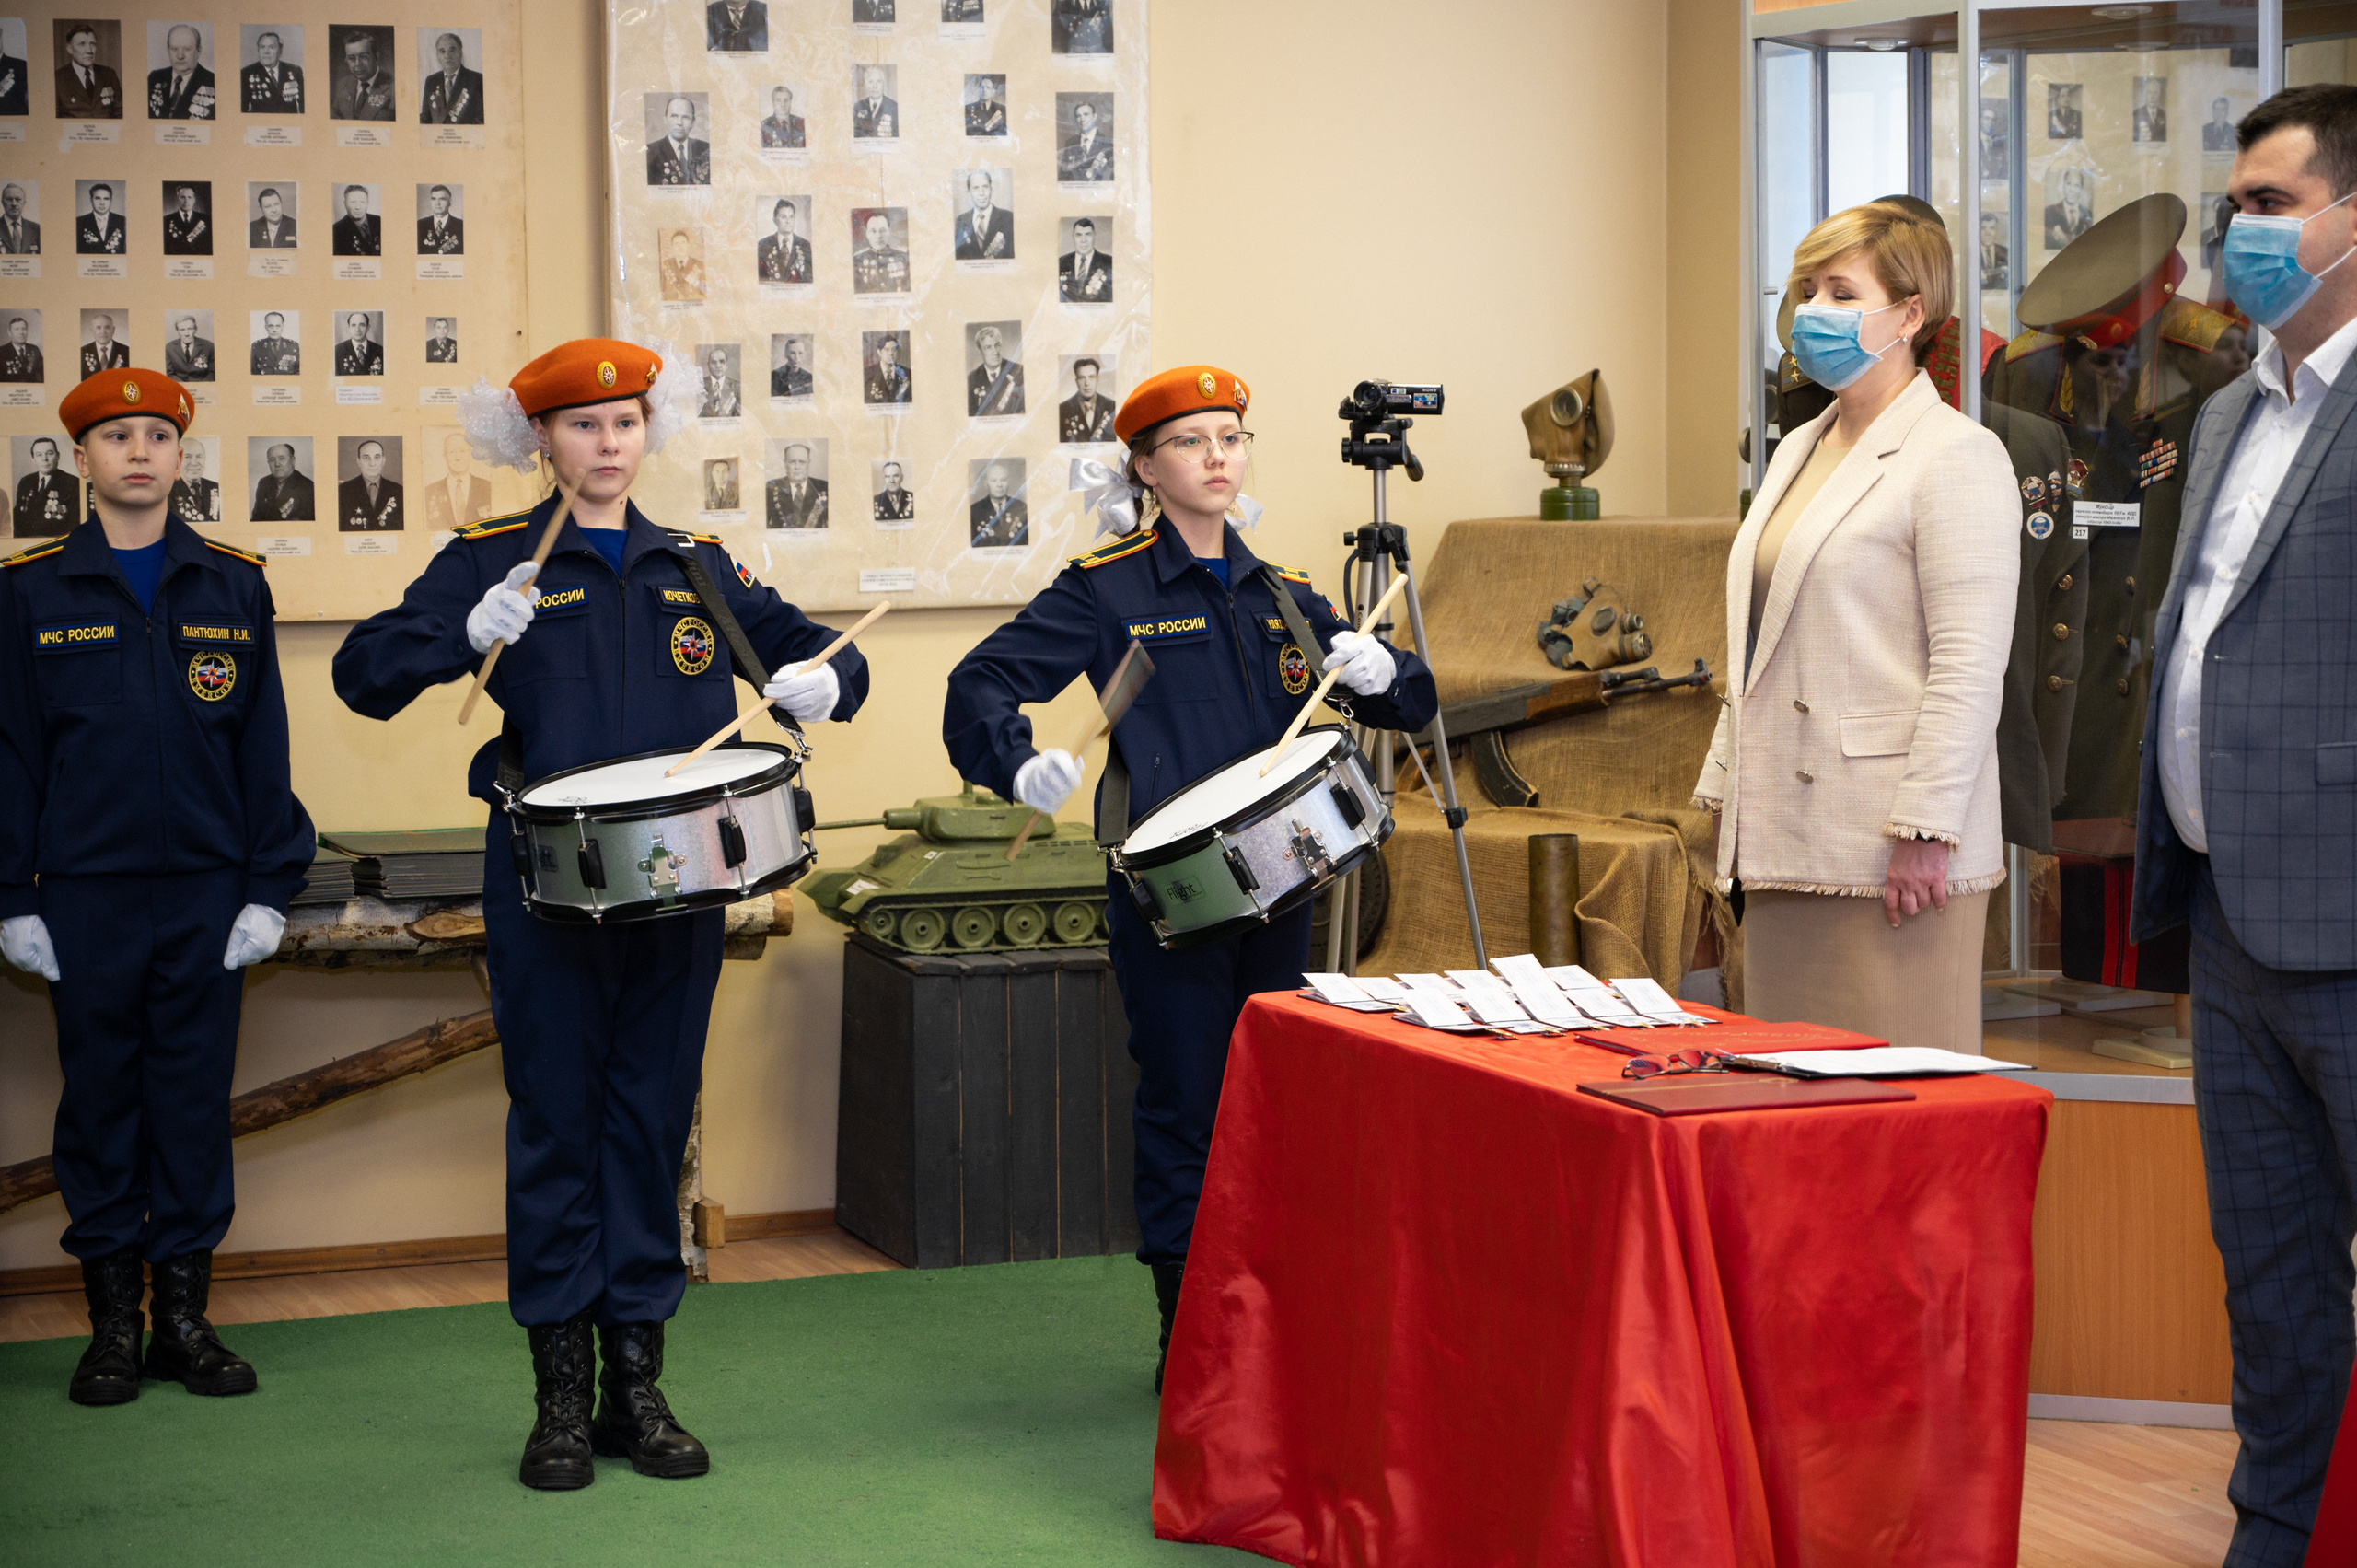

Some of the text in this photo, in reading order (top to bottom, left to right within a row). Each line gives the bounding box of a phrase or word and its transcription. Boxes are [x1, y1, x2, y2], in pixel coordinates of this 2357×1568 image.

[535, 587, 585, 610] РОССИИ
[40, 625, 115, 645] МЧС РОССИИ
[182, 625, 250, 641] ПАНТЮХИН Н.И.
[1129, 616, 1206, 636] МЧС РОССИИ
[674, 648, 711, 673] EMERCOM
[191, 678, 232, 699] EMERCOM
[1166, 882, 1197, 901] Flight
